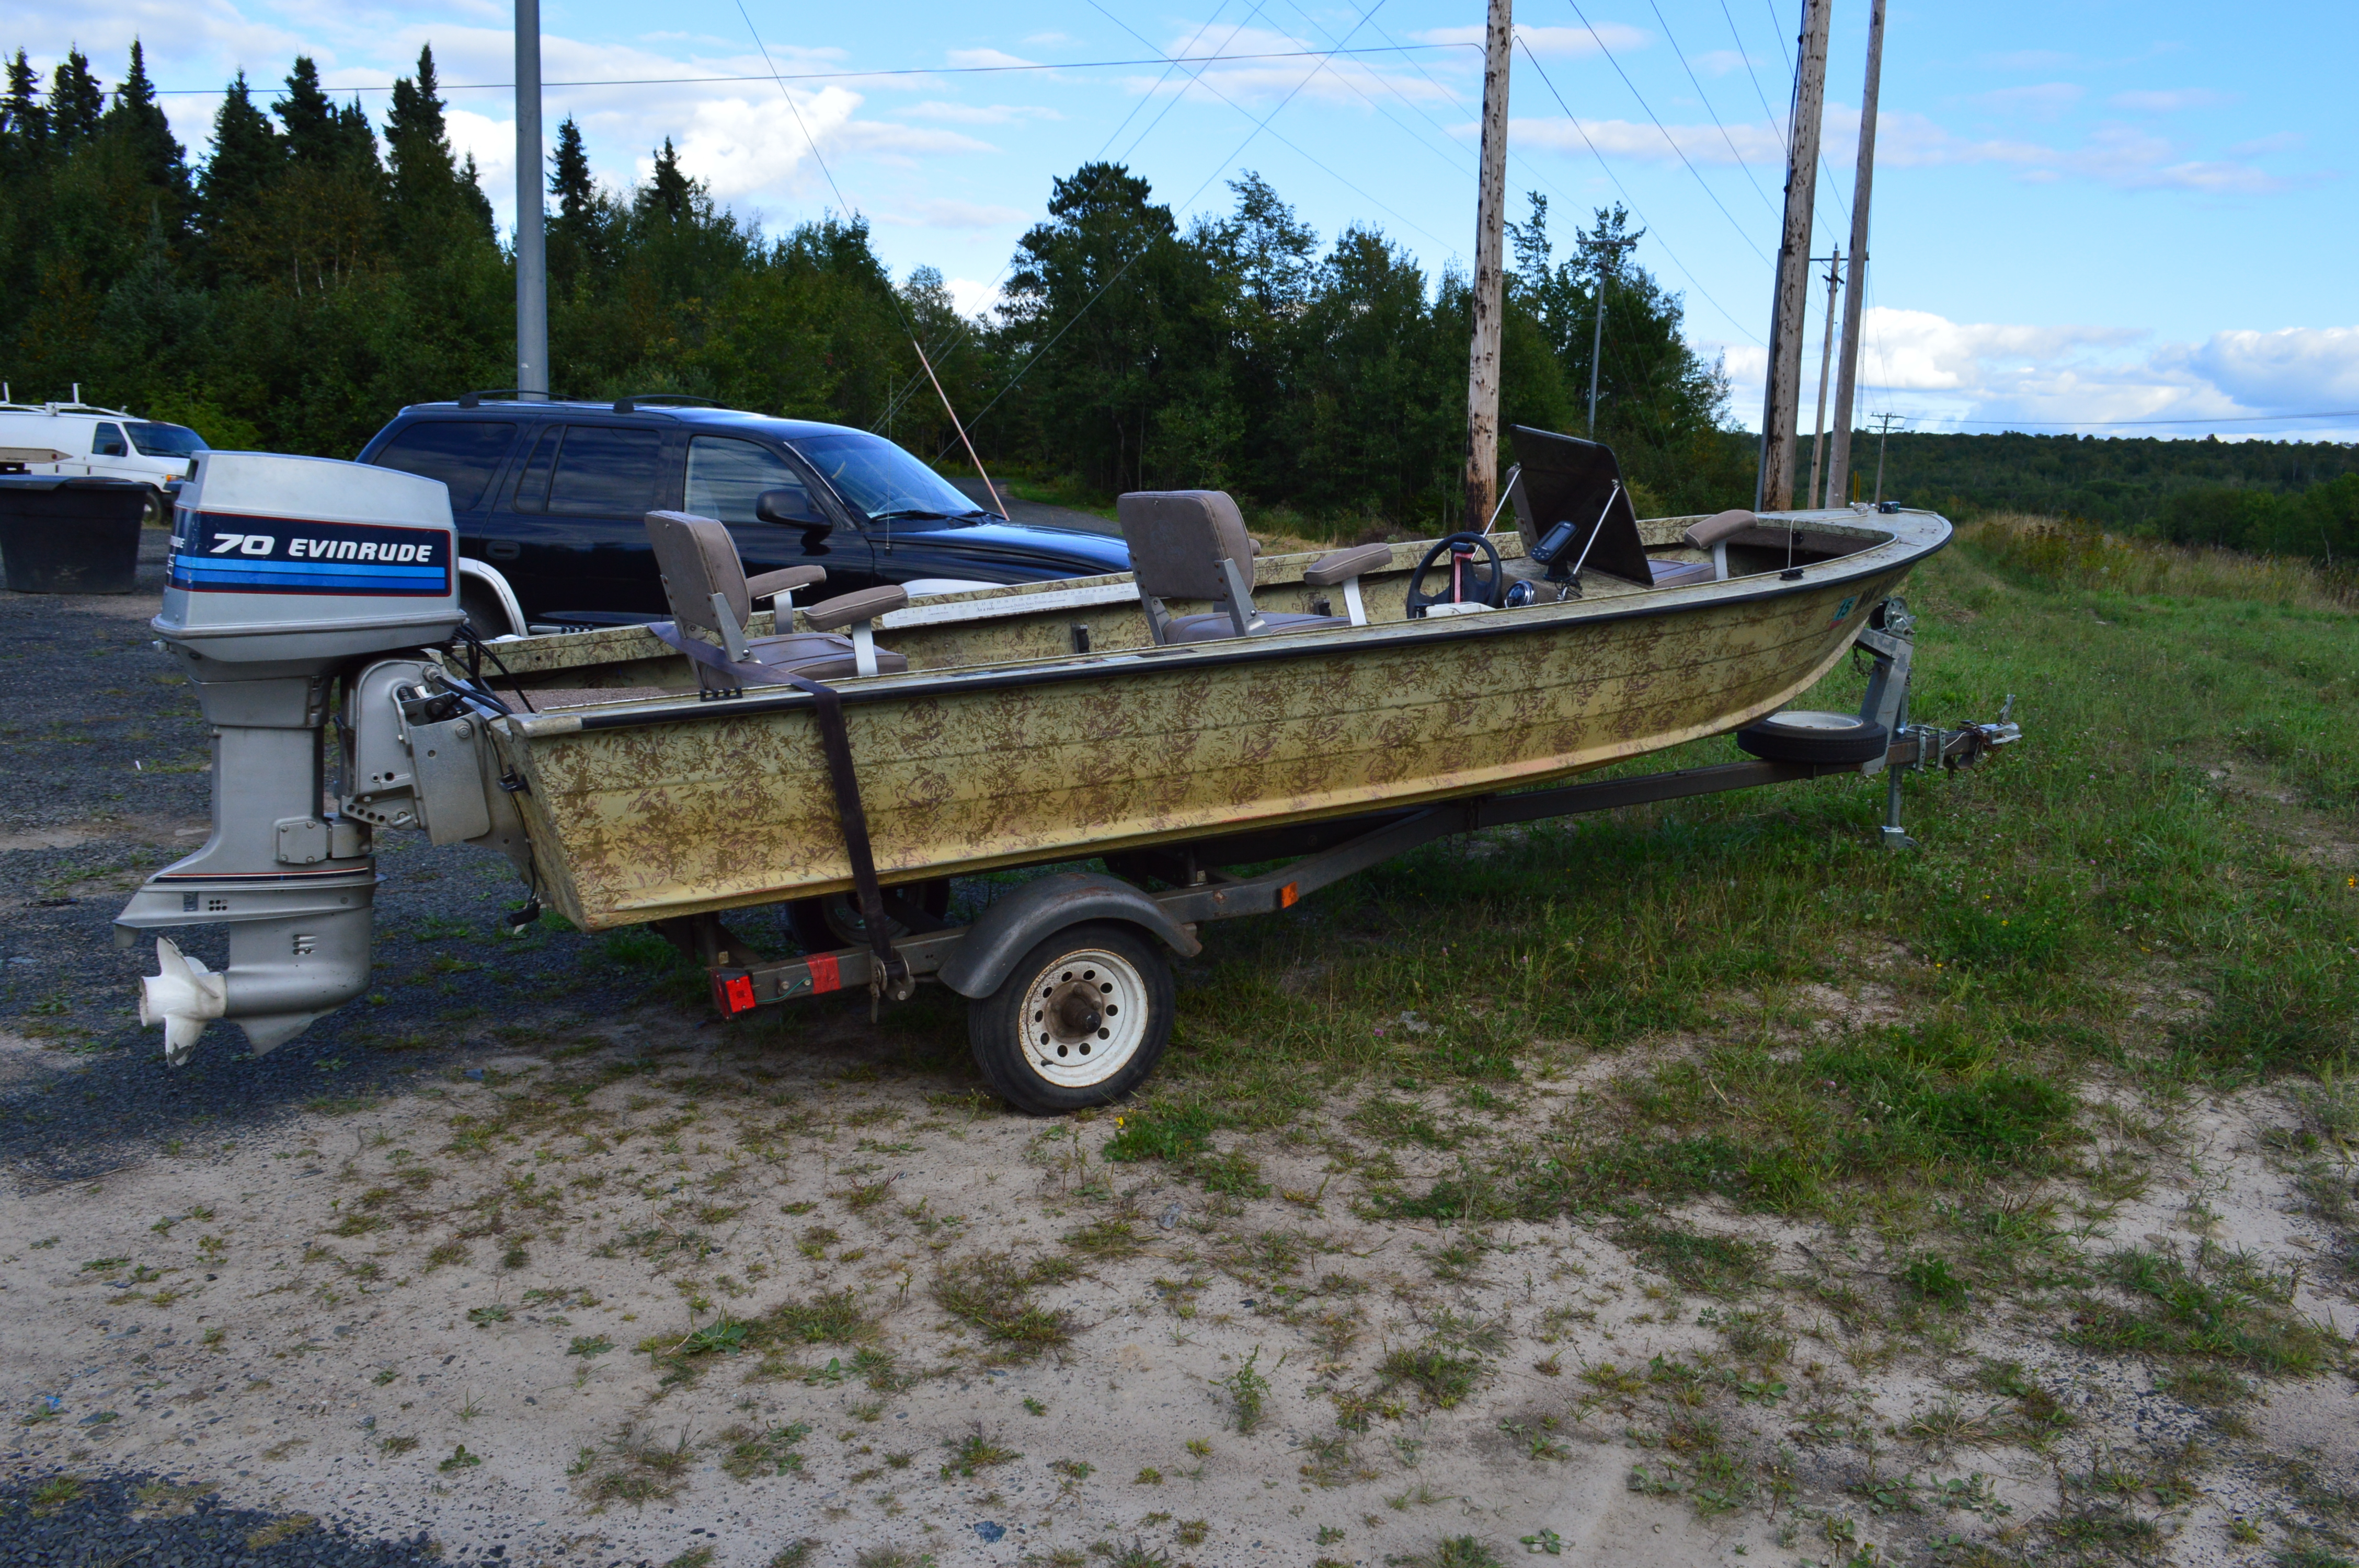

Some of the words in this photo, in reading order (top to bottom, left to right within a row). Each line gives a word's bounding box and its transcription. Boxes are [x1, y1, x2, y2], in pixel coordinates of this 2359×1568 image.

[209, 533, 275, 555] 70
[289, 538, 432, 562] EVINRUDE
[1837, 601, 1853, 617] 15
